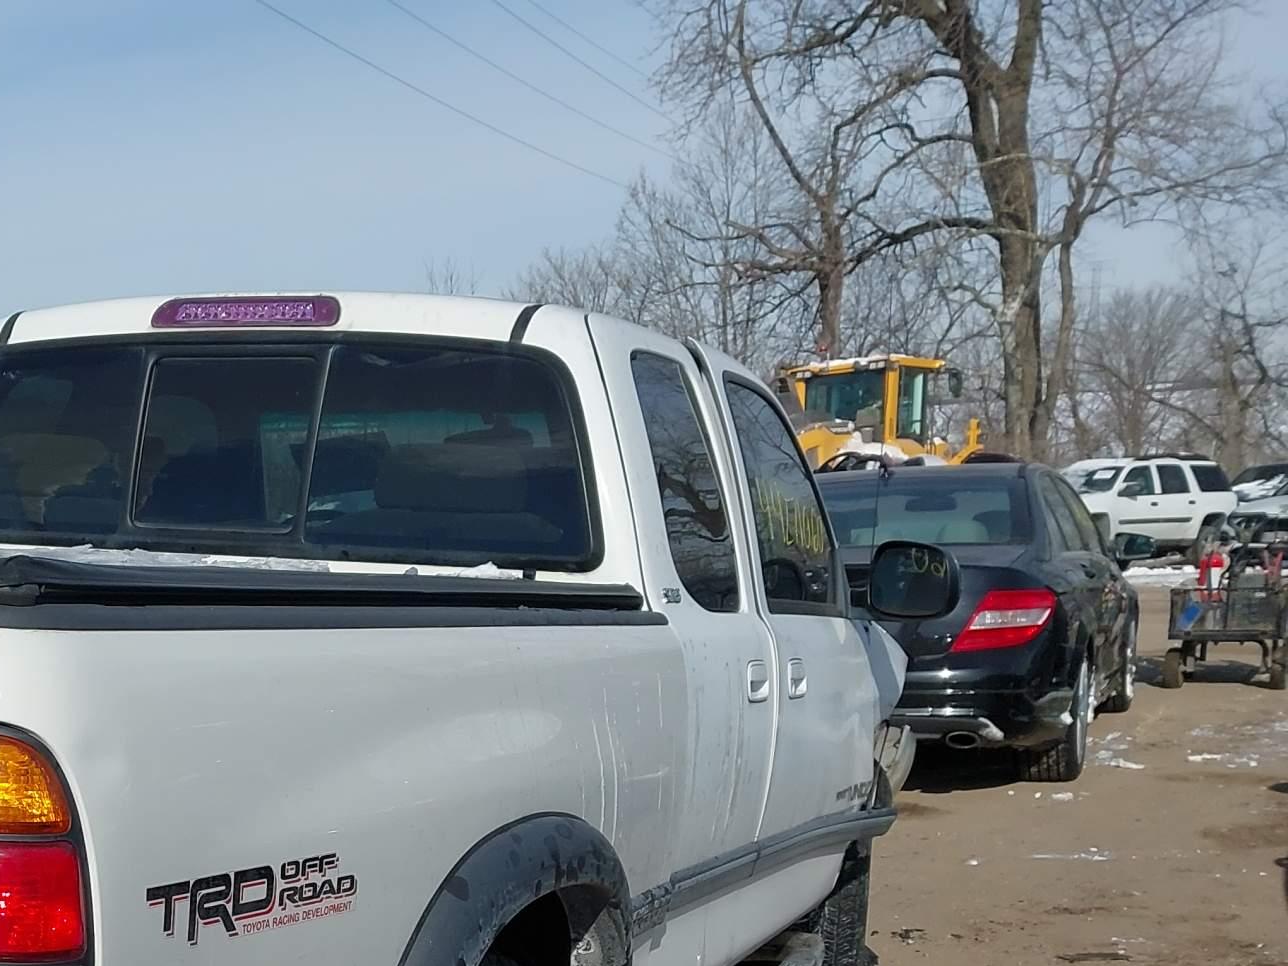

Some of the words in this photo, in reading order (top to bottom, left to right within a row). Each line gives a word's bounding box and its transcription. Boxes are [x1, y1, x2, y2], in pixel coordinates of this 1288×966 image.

[279, 852, 340, 884] OFF
[145, 864, 276, 946] TRD
[278, 875, 358, 911] ROAD
[241, 919, 272, 935] TOYOTA
[272, 911, 301, 928] RACING
[301, 900, 353, 922] DEVELOPMENT
